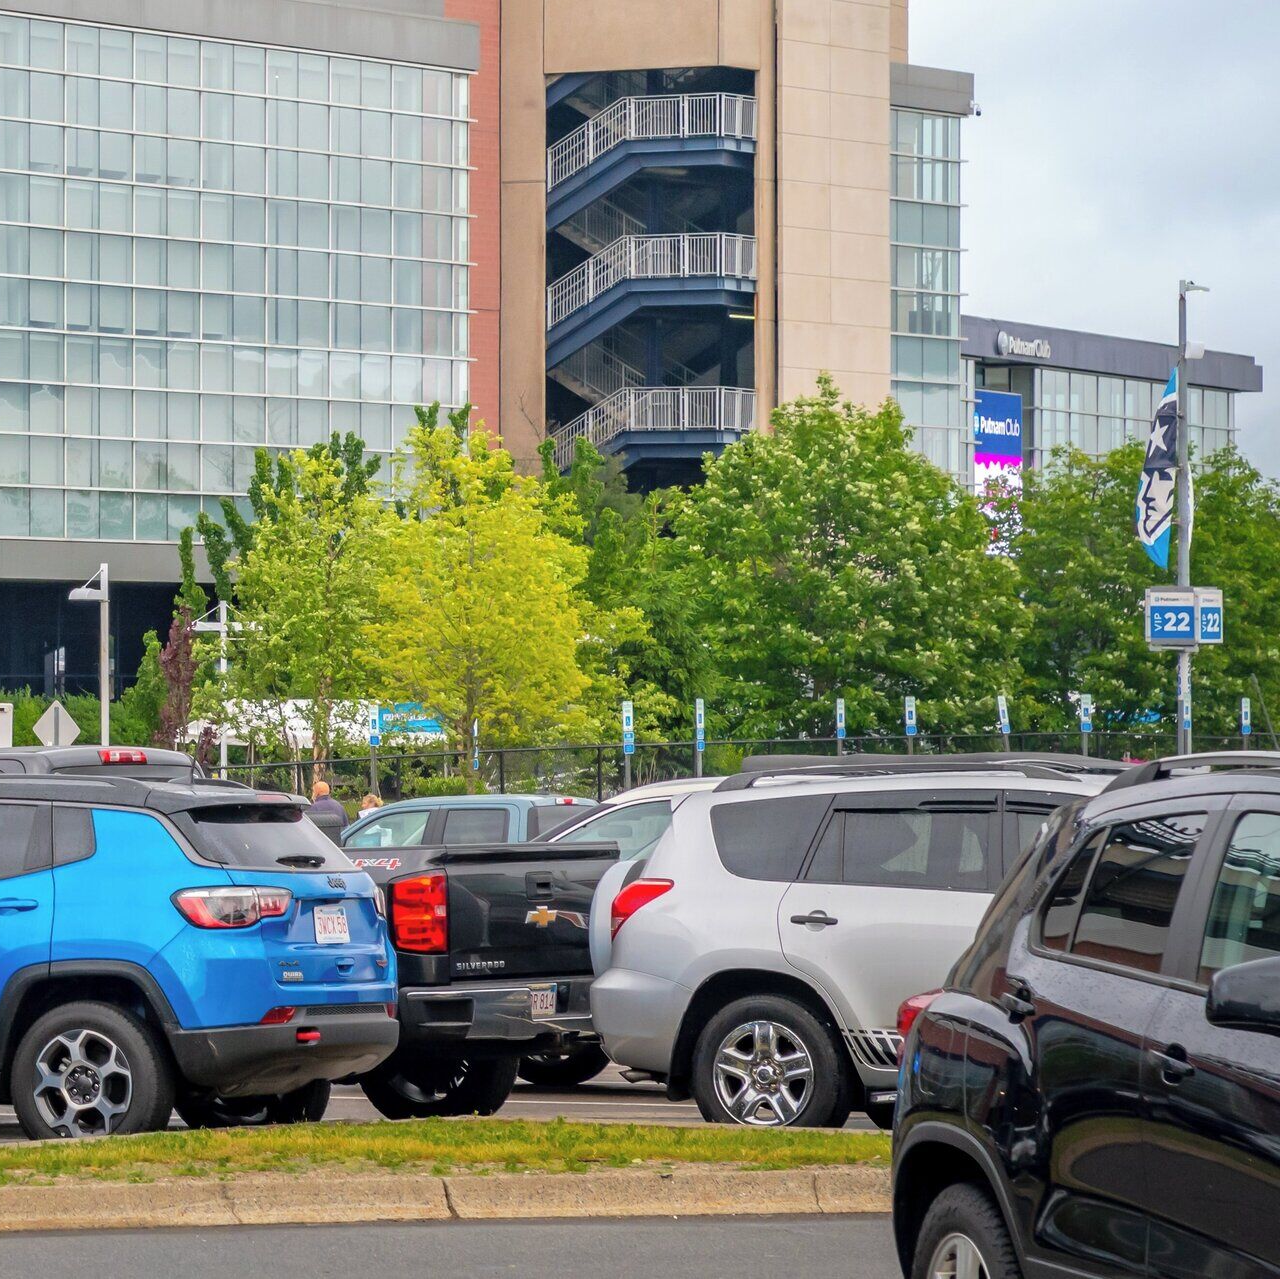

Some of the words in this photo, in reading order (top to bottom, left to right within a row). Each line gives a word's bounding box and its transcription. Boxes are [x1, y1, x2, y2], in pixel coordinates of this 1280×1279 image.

[1009, 336, 1036, 356] Putnam
[1035, 339, 1051, 358] Club
[980, 416, 1005, 435] Putnam
[1005, 418, 1020, 437] Club
[1154, 612, 1162, 631] VIP
[1163, 611, 1191, 632] 22
[1206, 612, 1220, 632] 22
[456, 960, 505, 971] SILVERADO
[540, 993, 555, 1010] 814
